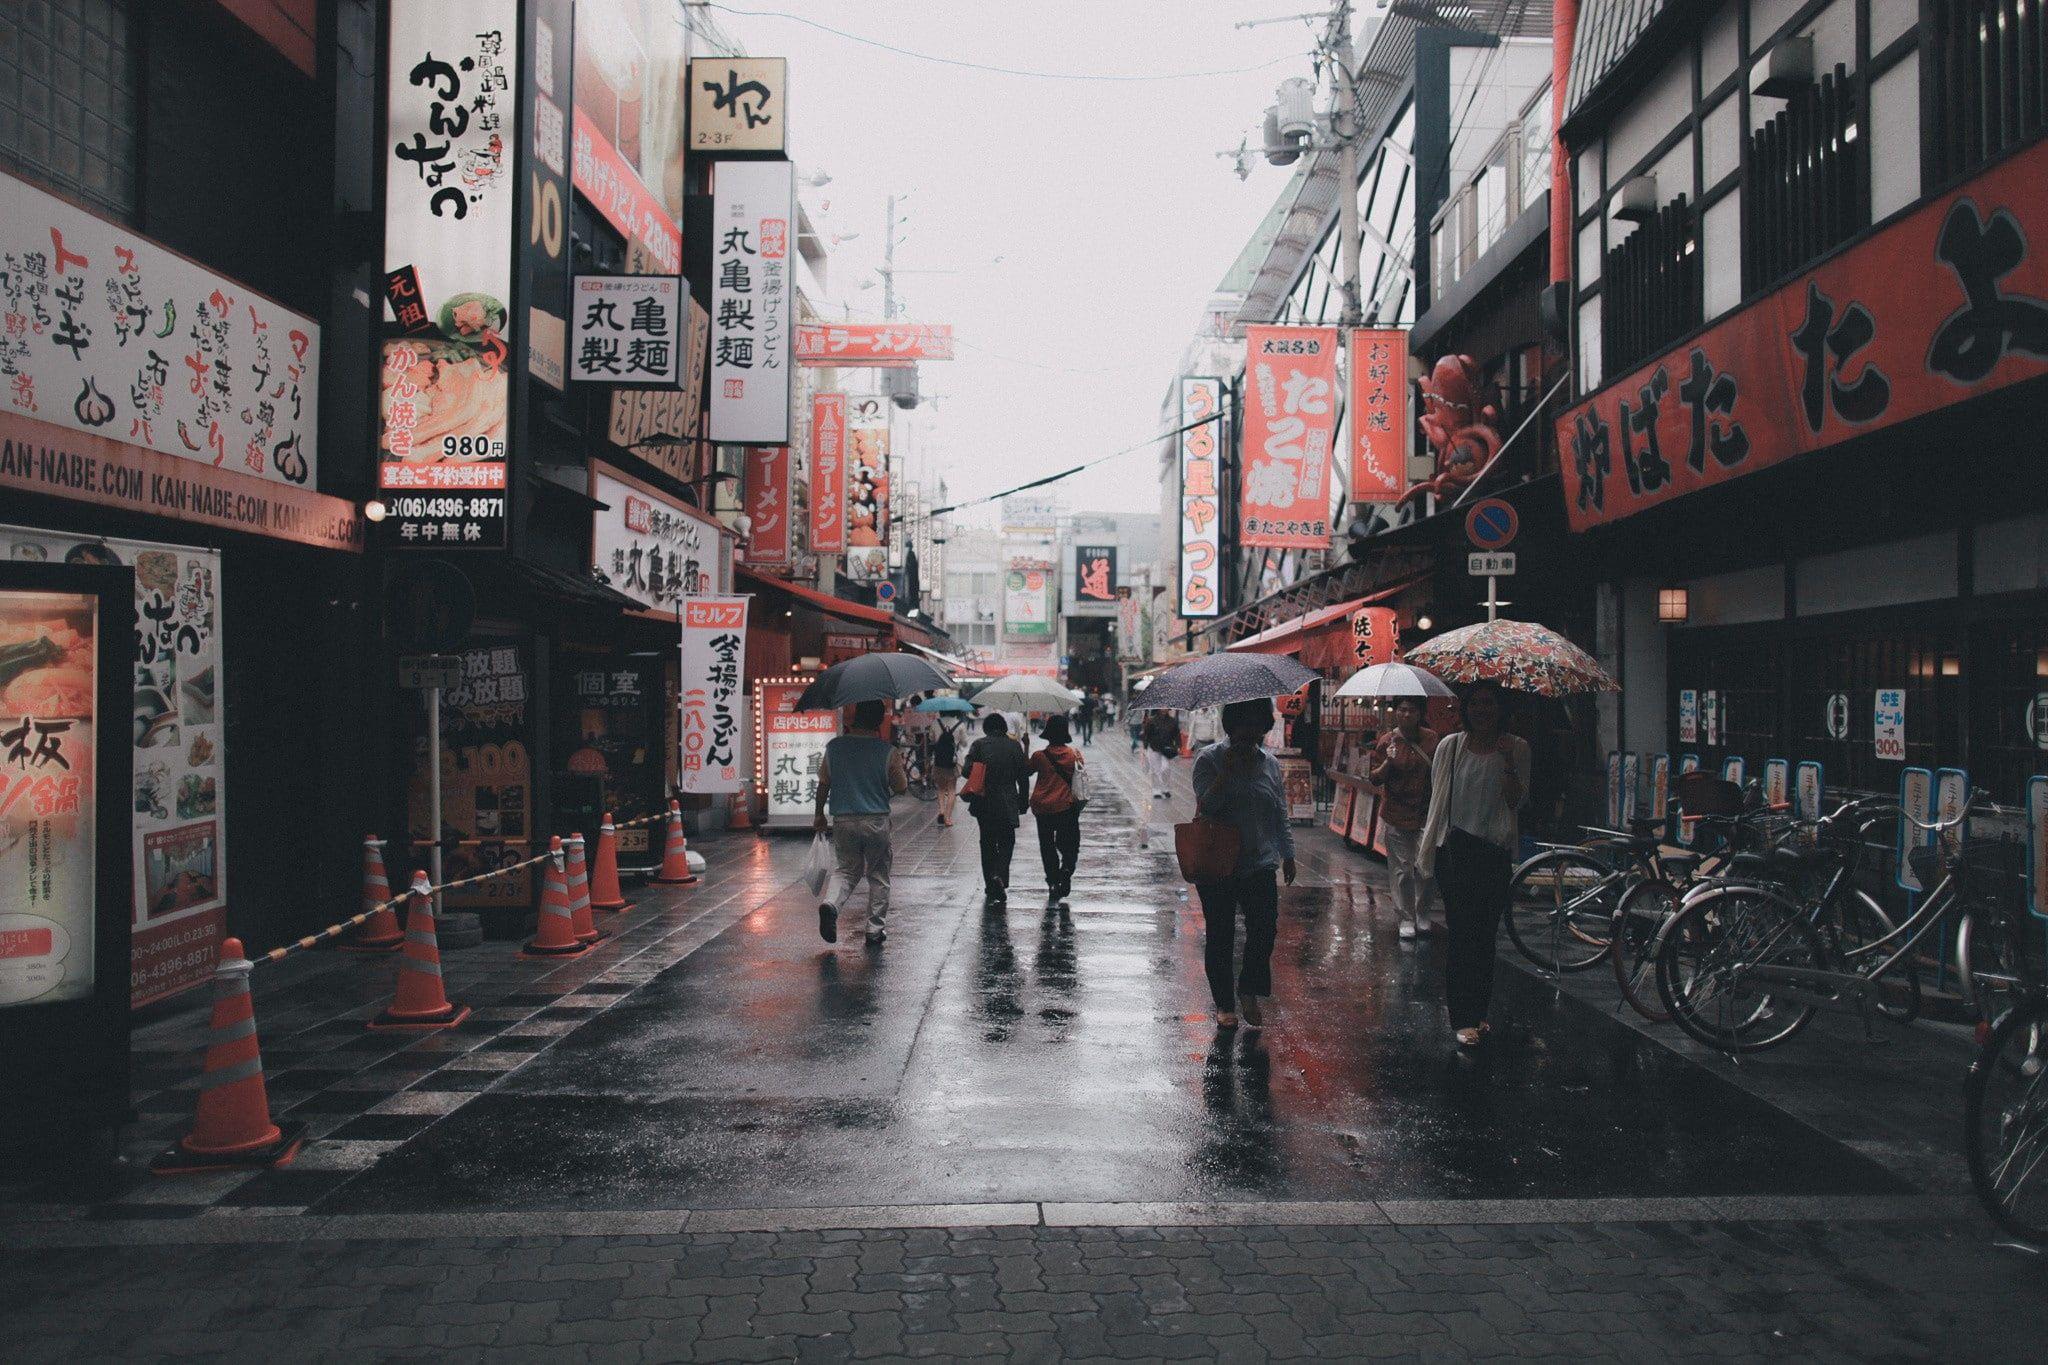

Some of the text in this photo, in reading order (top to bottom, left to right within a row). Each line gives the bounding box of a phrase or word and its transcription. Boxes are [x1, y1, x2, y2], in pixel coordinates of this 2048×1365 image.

[389, 275, 424, 327] 元祖
[715, 227, 756, 369] 丸亀製麺
[582, 296, 668, 336] 丸亀
[761, 261, 783, 369] 釜揚げうどん
[578, 337, 670, 376] 製麺
[1262, 339, 1321, 355] 大阪名物
[444, 436, 504, 456] 980円
[152, 477, 267, 527] KAN-NABE.COM
[398, 498, 504, 518] (06)4396-8871
[1184, 383, 1218, 610] うる星やつら
[400, 521, 481, 541] 年中無休
[1470, 558, 1513, 570] 自動車
[688, 605, 744, 625] セルフ
[465, 648, 518, 678] 放題
[440, 674, 526, 706] み放題
[575, 669, 642, 696] 個室
[706, 633, 741, 767] 釜揚げうどん
[773, 715, 833, 730] 店内54席
[1875, 712, 1903, 726] ビール
